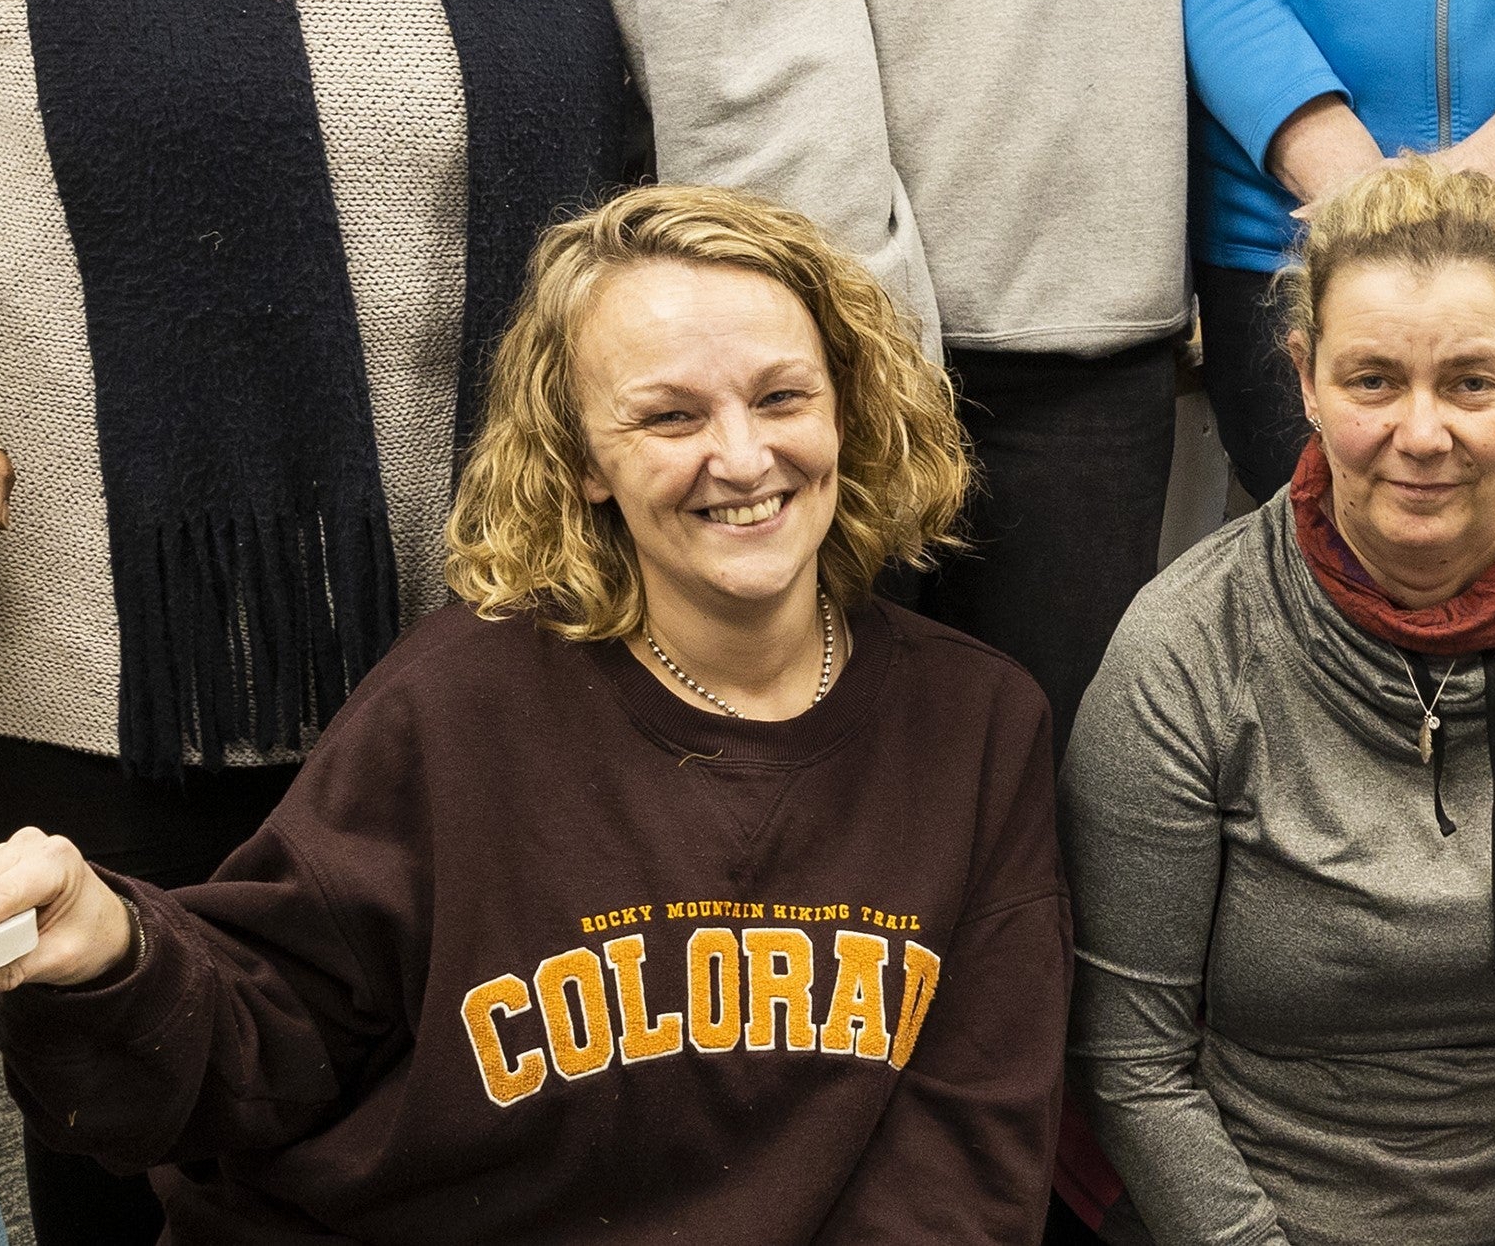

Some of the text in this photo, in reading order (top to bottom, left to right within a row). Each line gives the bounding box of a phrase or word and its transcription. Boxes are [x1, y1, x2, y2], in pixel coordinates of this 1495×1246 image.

[580, 901, 922, 934] ROCKY MOUNTAIN HIKING TRAIL
[460, 927, 942, 1108] COLORAD
